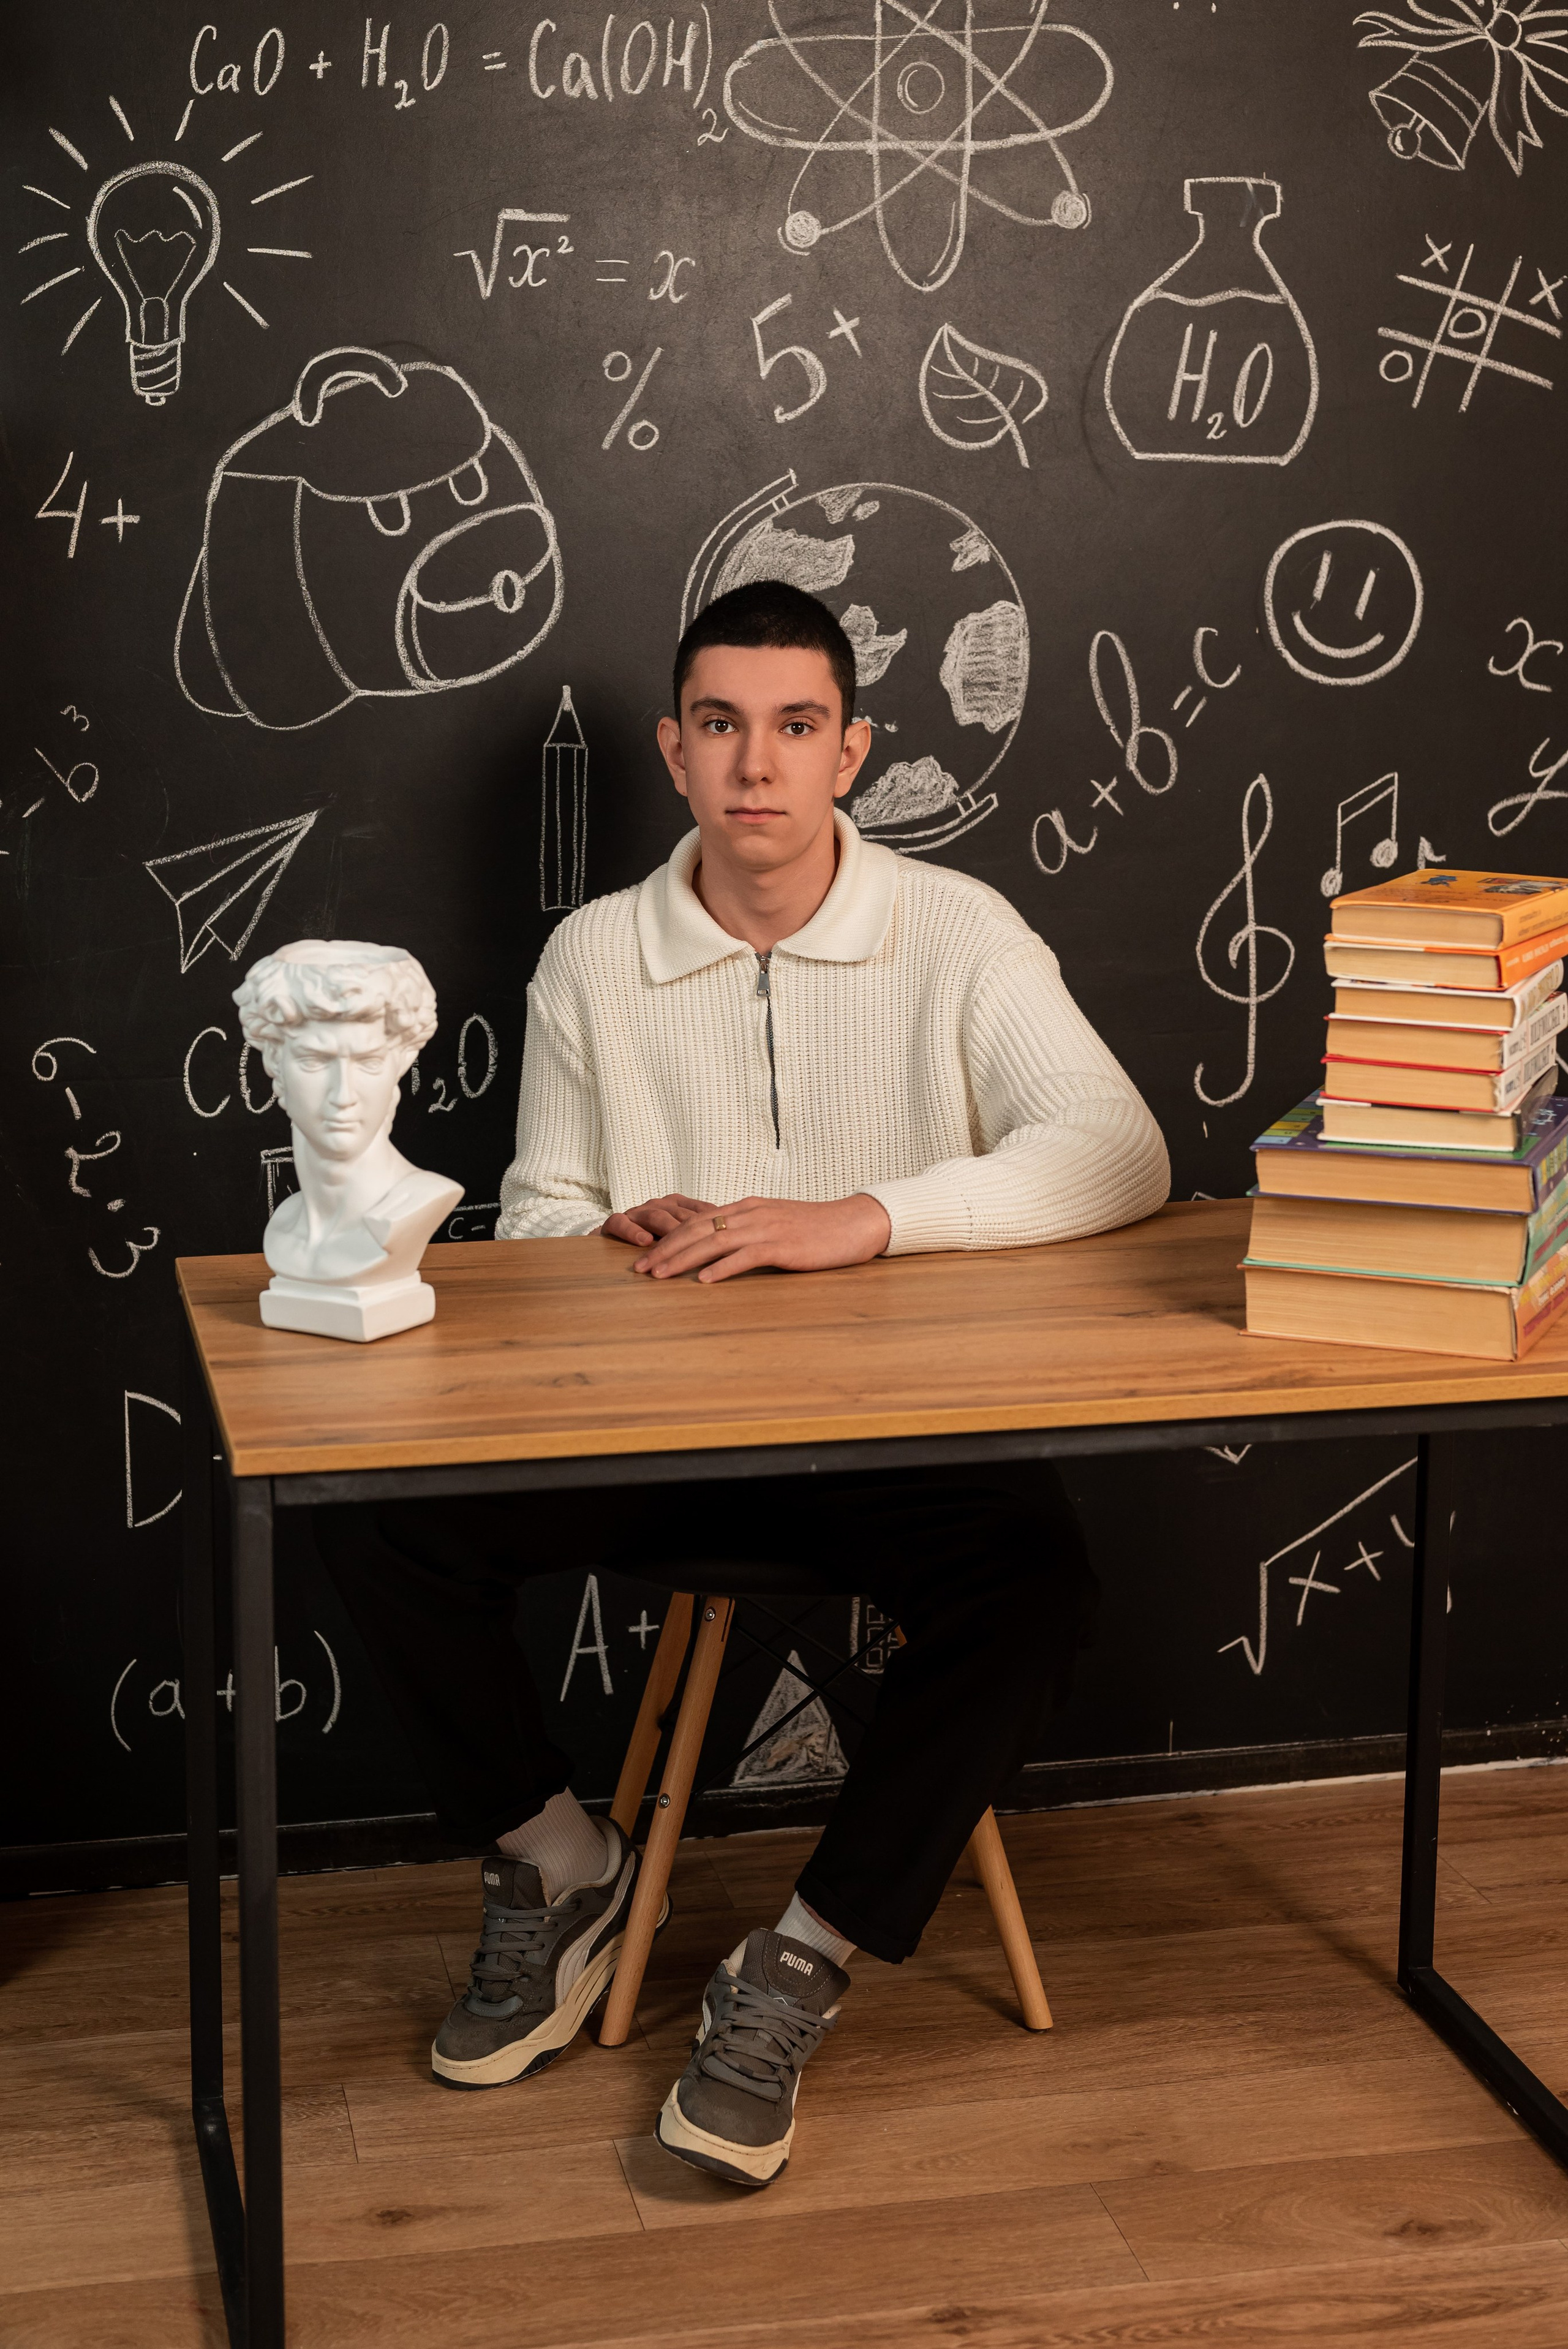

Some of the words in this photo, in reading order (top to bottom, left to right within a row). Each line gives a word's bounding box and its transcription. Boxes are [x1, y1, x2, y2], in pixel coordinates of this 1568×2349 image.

[189, 25, 285, 96] CaO
[601, 347, 665, 451] %
[779, 1951, 814, 1976] PUMA
